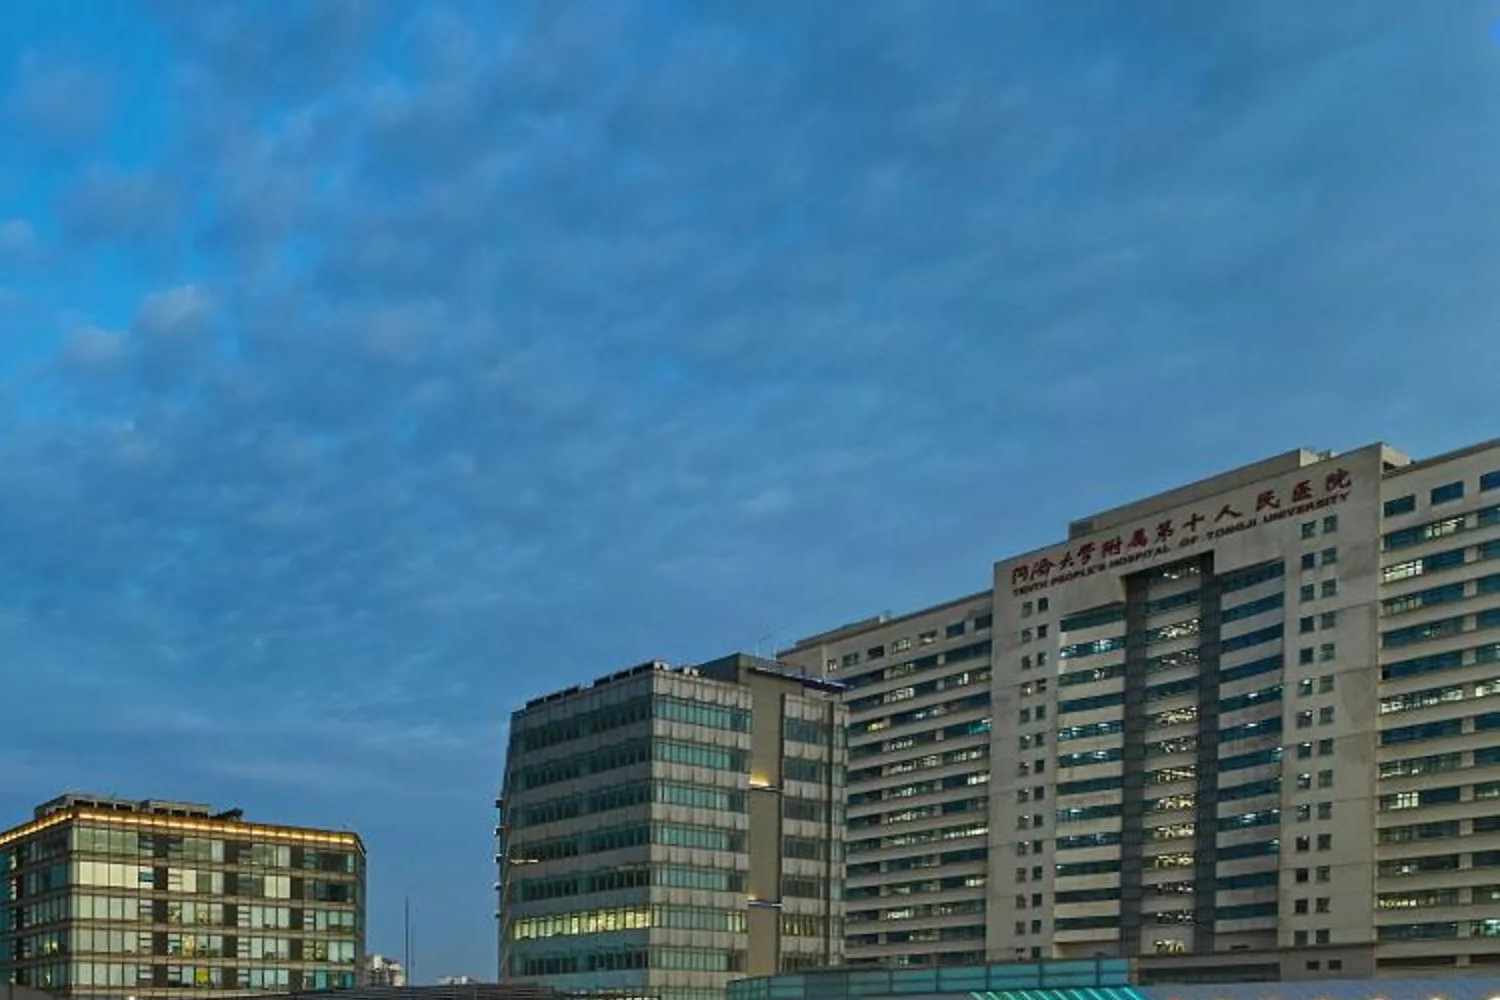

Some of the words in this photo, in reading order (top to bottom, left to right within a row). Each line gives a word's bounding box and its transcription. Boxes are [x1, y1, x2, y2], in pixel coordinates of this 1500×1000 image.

[1109, 544, 1171, 568] HOSPITAL
[1179, 535, 1199, 548] OF
[1206, 518, 1258, 541] TONGJI
[1263, 491, 1352, 523] UNIVERSITY
